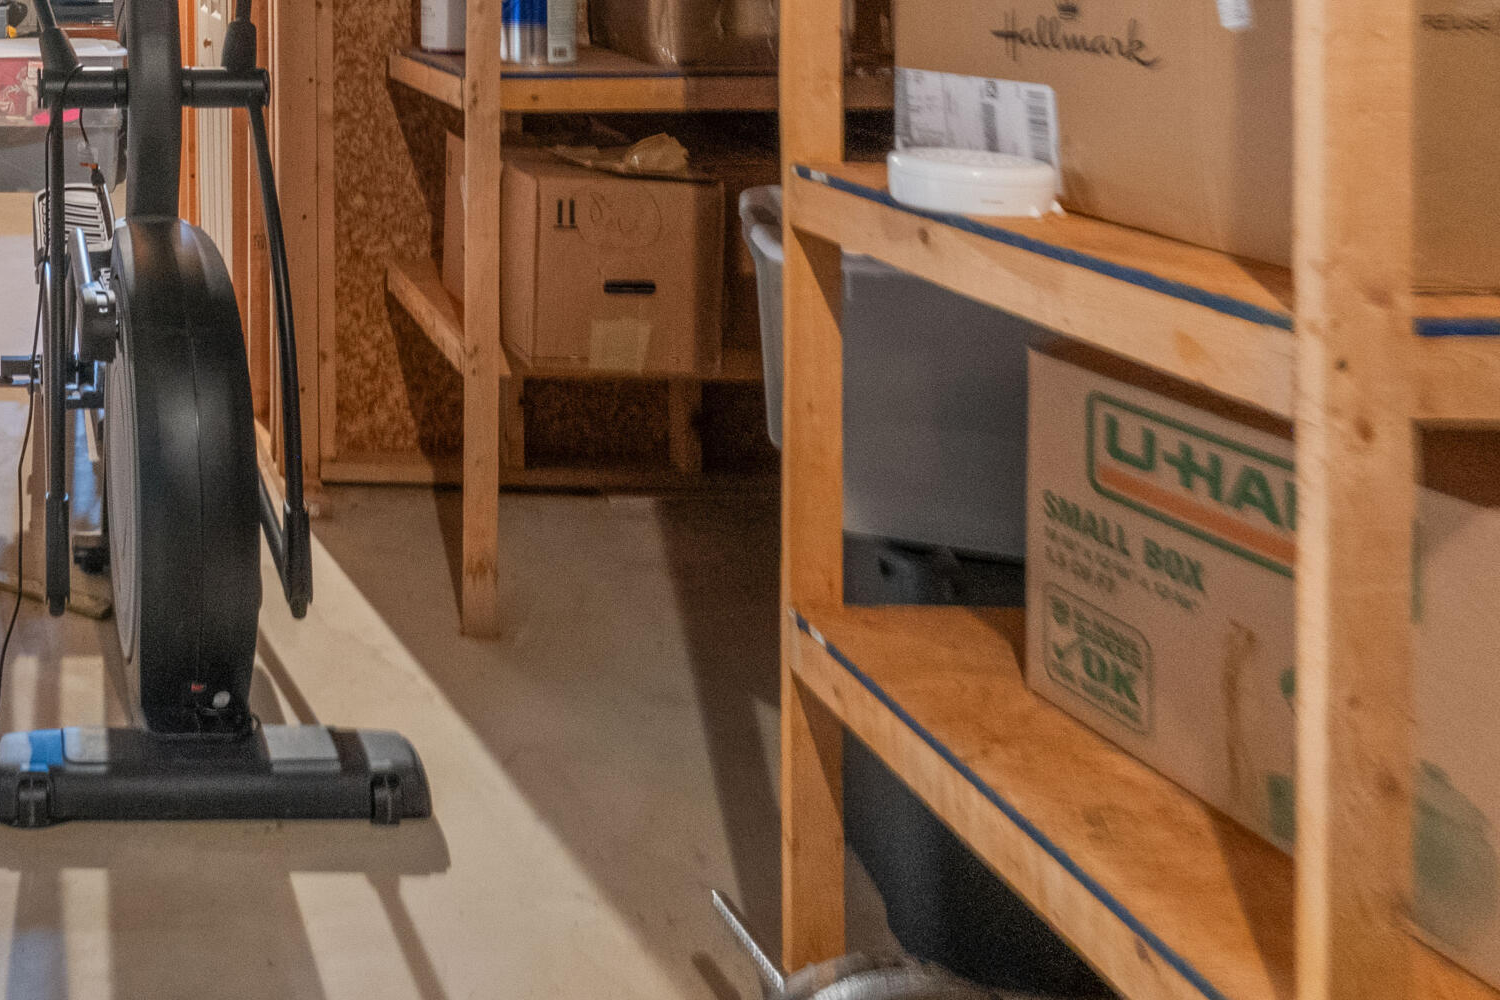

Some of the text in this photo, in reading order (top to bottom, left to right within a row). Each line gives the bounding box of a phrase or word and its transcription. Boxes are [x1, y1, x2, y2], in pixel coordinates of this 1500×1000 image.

[991, 7, 1161, 69] Hallmark
[1043, 489, 1131, 557] SMALL
[1142, 536, 1205, 592] BOX
[1081, 643, 1141, 707] OK
